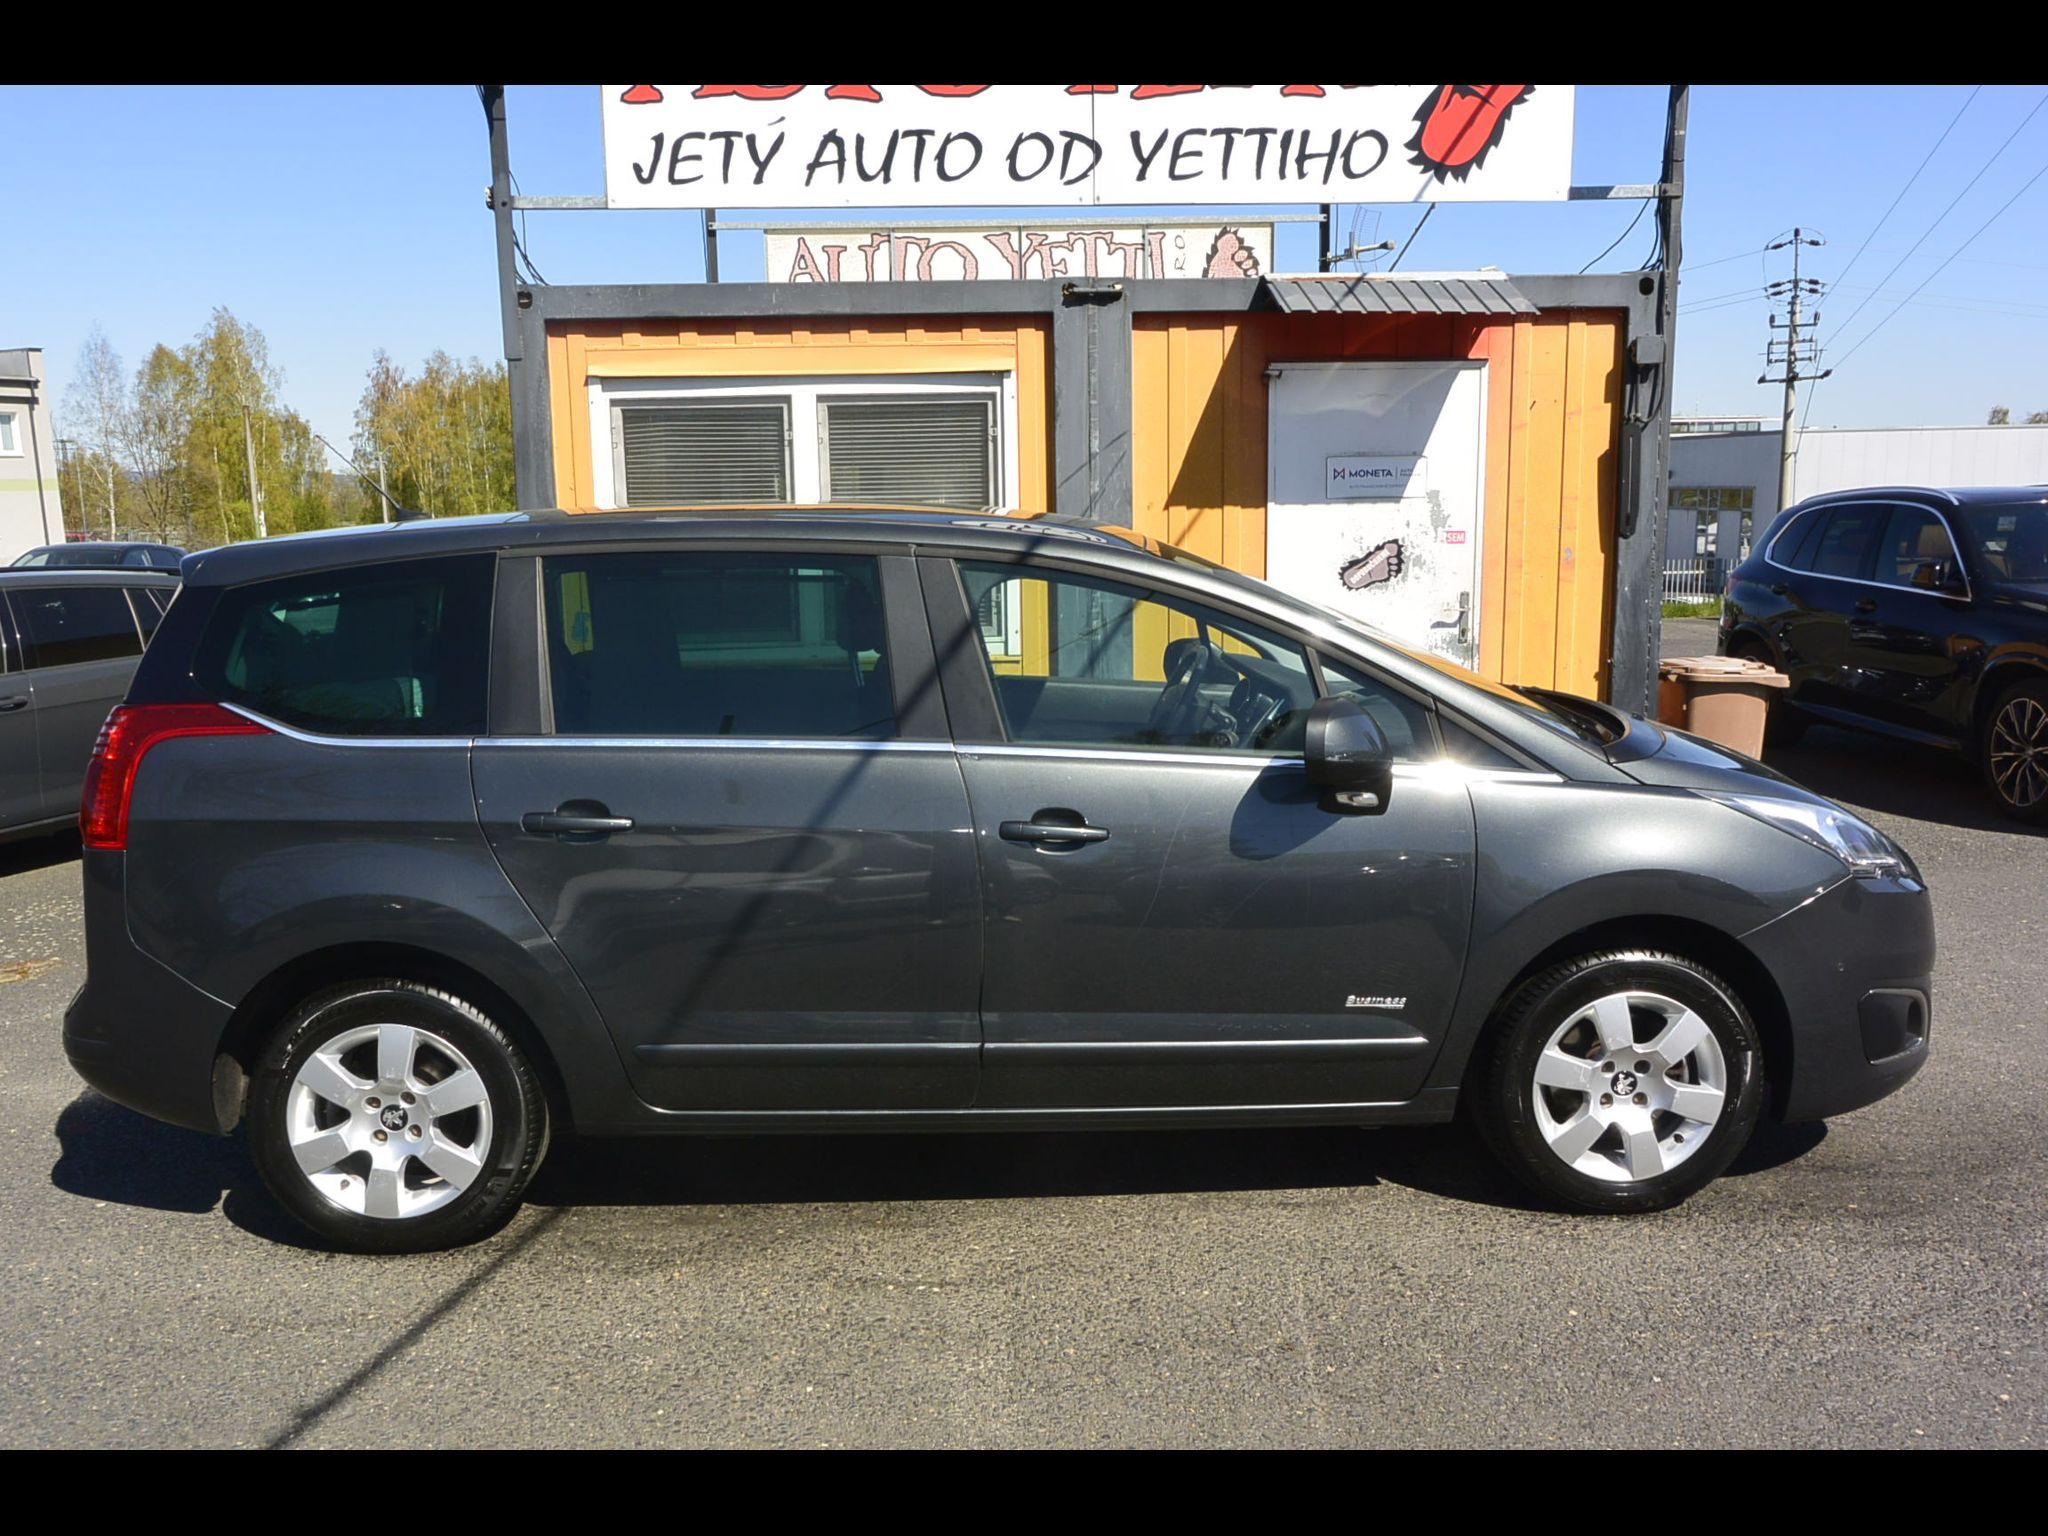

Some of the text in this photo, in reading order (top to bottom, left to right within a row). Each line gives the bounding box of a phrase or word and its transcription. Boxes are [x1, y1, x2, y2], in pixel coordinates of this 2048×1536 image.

[632, 116, 1389, 187] JETÝ AUTO OD YETTIHO
[1349, 468, 1393, 478] MONETA
[1345, 994, 1407, 1005] Business
